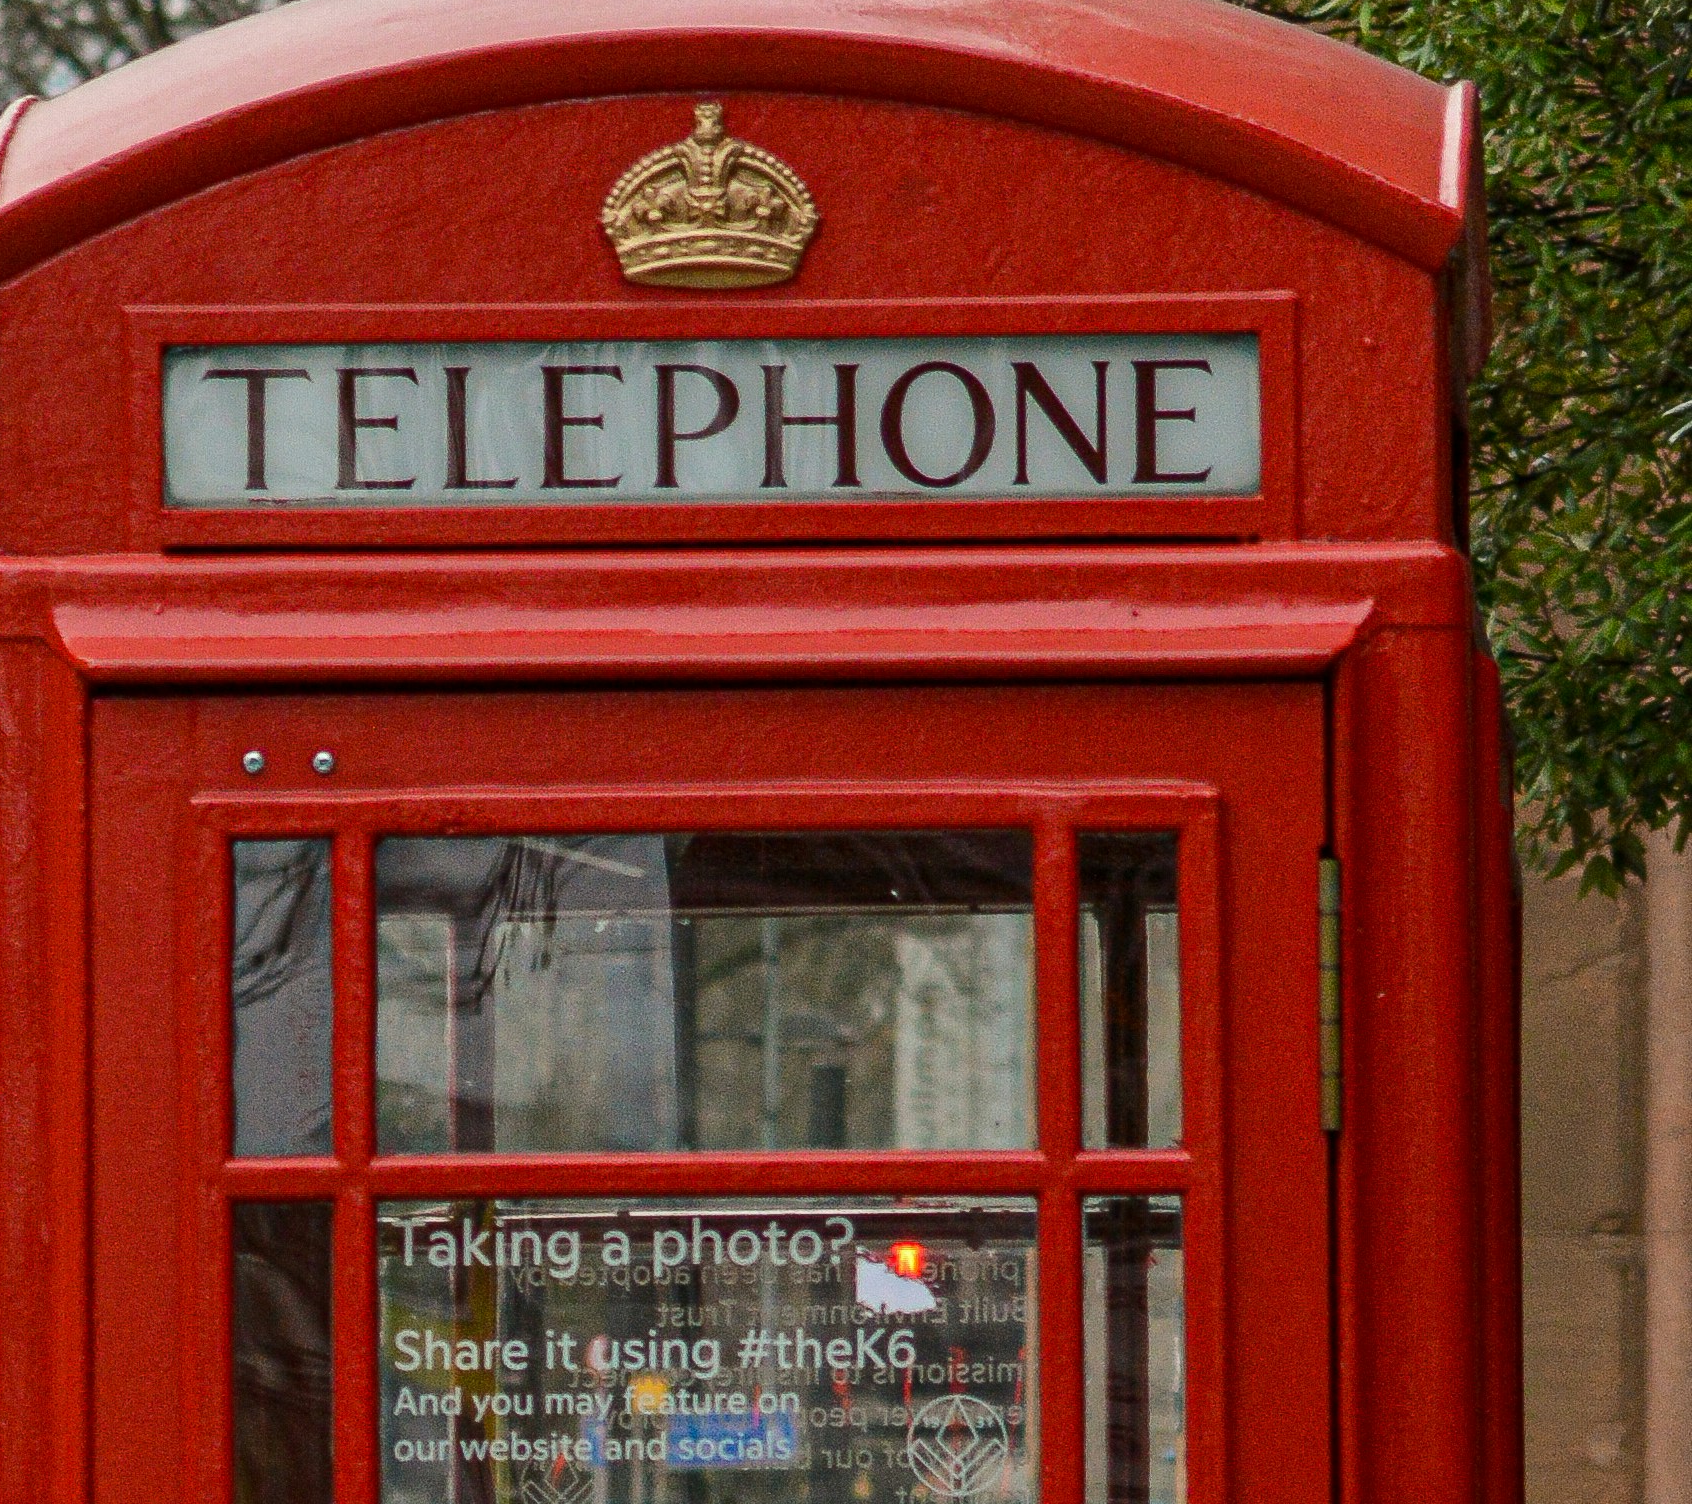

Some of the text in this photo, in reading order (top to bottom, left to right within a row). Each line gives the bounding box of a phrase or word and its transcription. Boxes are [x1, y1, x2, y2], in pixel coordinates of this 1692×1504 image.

[200, 357, 1214, 493] TELEPHONE
[392, 1216, 855, 1279] Taking a photo?
[393, 1327, 917, 1379] Share it using #theK6
[393, 1386, 463, 1416] And
[470, 1393, 534, 1423] you
[544, 1393, 613, 1422] may
[623, 1385, 754, 1416] feature
[759, 1392, 800, 1415] on
[393, 1439, 452, 1463] our
[460, 1432, 593, 1463] website
[605, 1432, 668, 1462] and
[678, 1432, 793, 1462] socials
